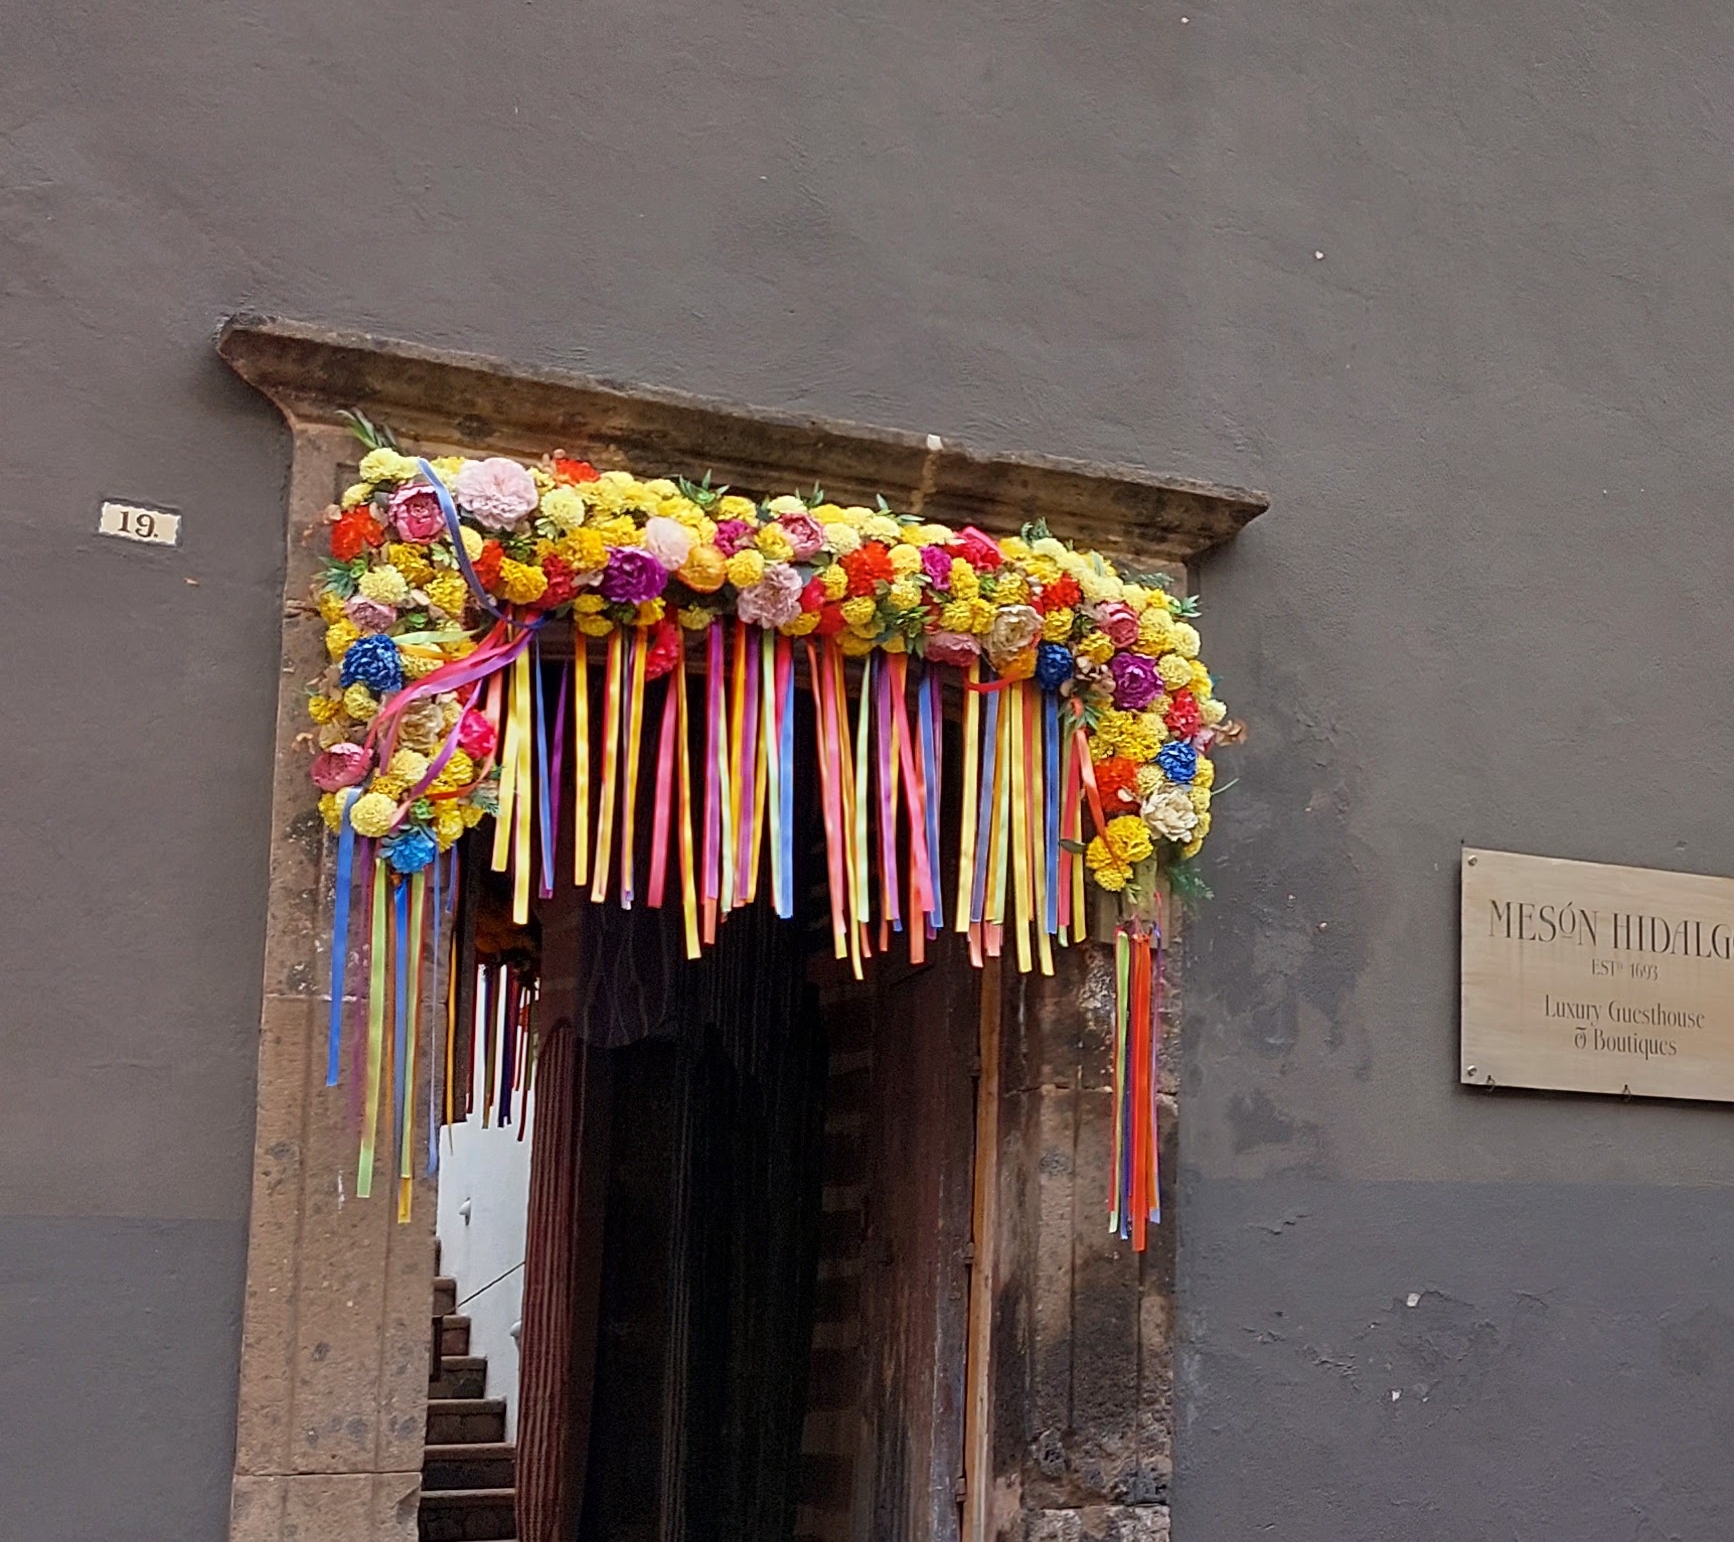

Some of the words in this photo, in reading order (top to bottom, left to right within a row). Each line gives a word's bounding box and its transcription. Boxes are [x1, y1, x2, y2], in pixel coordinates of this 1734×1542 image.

[1488, 900, 1600, 948] MESÓN
[1544, 994, 1602, 1026] Luxury
[1608, 1000, 1706, 1030] Guesthouse
[1593, 1028, 1678, 1060] Boutiques
